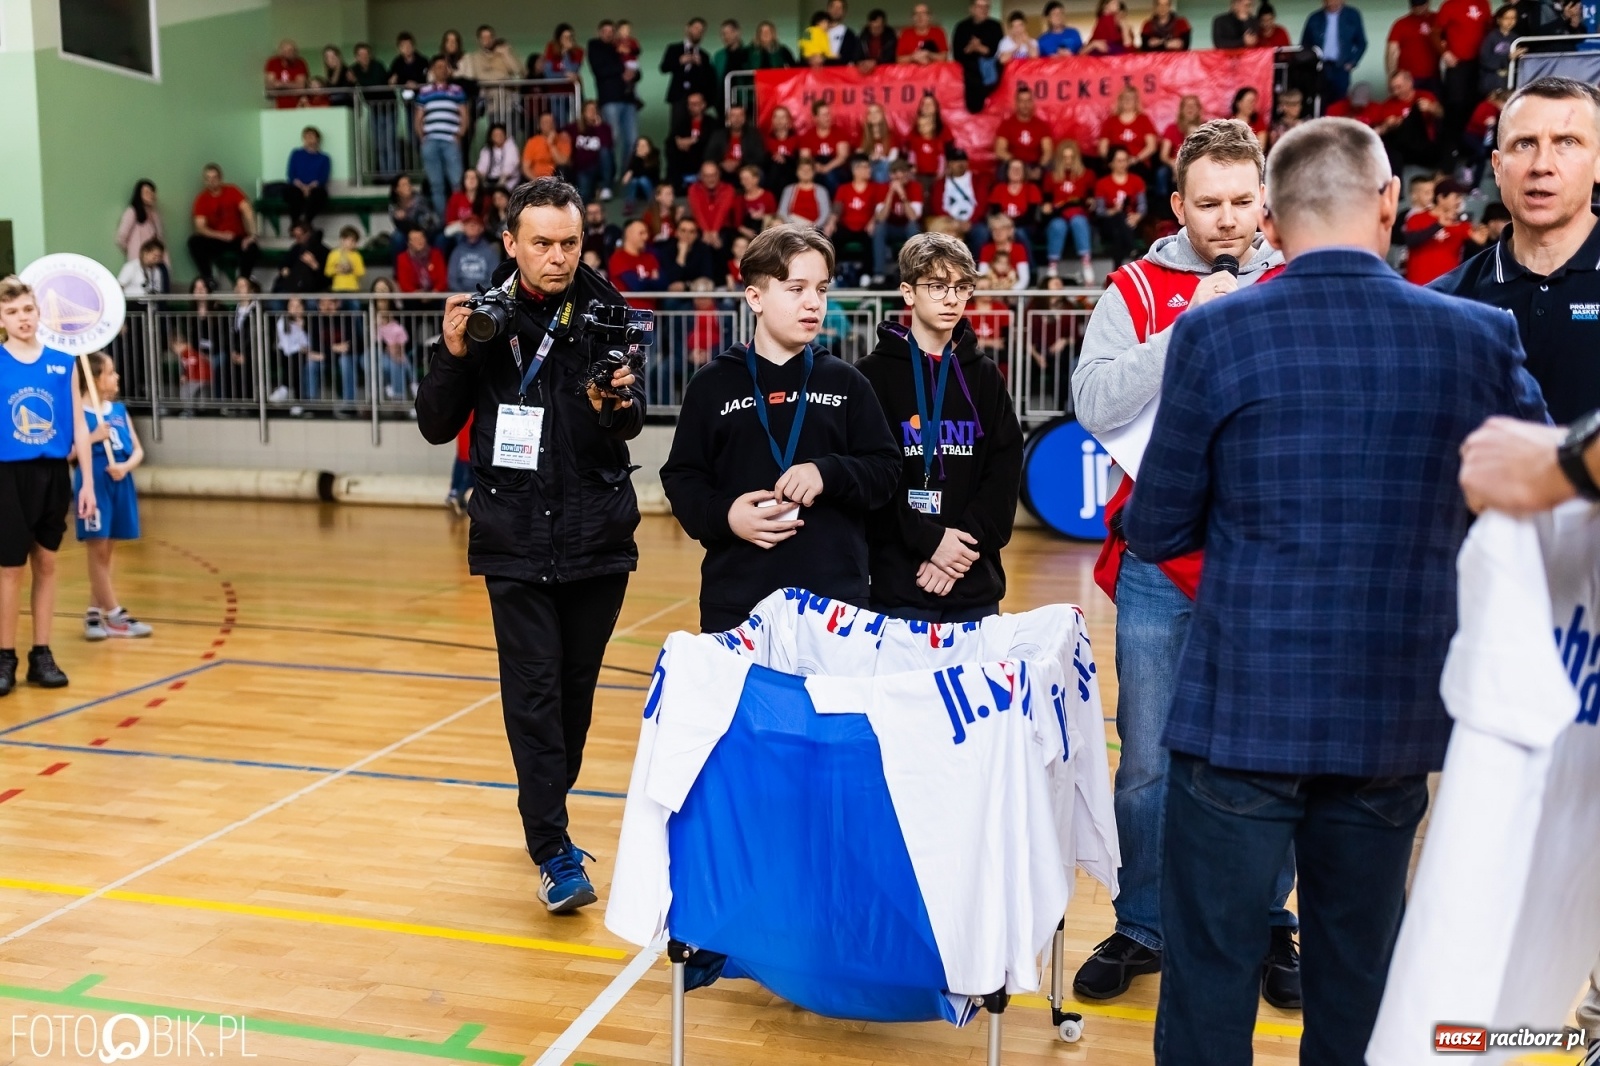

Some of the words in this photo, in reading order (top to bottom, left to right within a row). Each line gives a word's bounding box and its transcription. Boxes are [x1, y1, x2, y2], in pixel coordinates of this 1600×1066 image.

[1167, 300, 1188, 308] adidas
[560, 302, 573, 325] Nikon
[720, 396, 764, 416] JAC
[13, 429, 57, 445] WARRIORS
